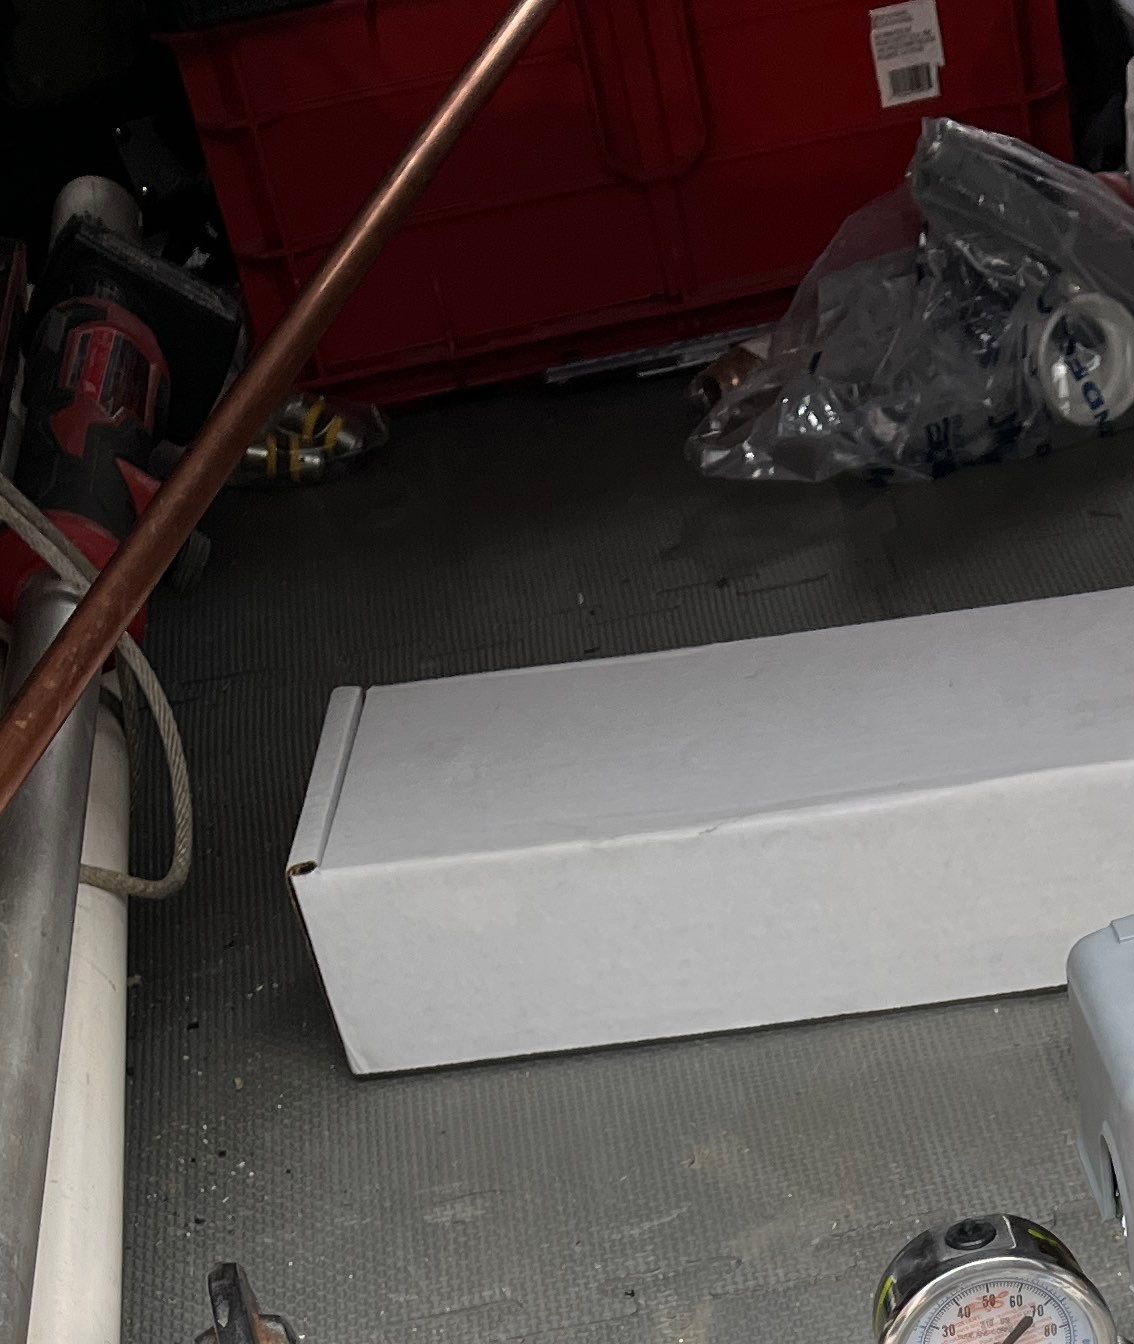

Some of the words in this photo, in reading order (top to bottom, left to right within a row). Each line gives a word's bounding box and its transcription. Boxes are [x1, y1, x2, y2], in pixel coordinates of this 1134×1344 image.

[982, 1294, 996, 1308] 50
[1009, 1294, 1023, 1308] 60
[957, 1305, 971, 1319] 40
[1030, 1304, 1044, 1317] 70
[941, 1323, 956, 1338] 30
[1044, 1323, 1057, 1337] 80
